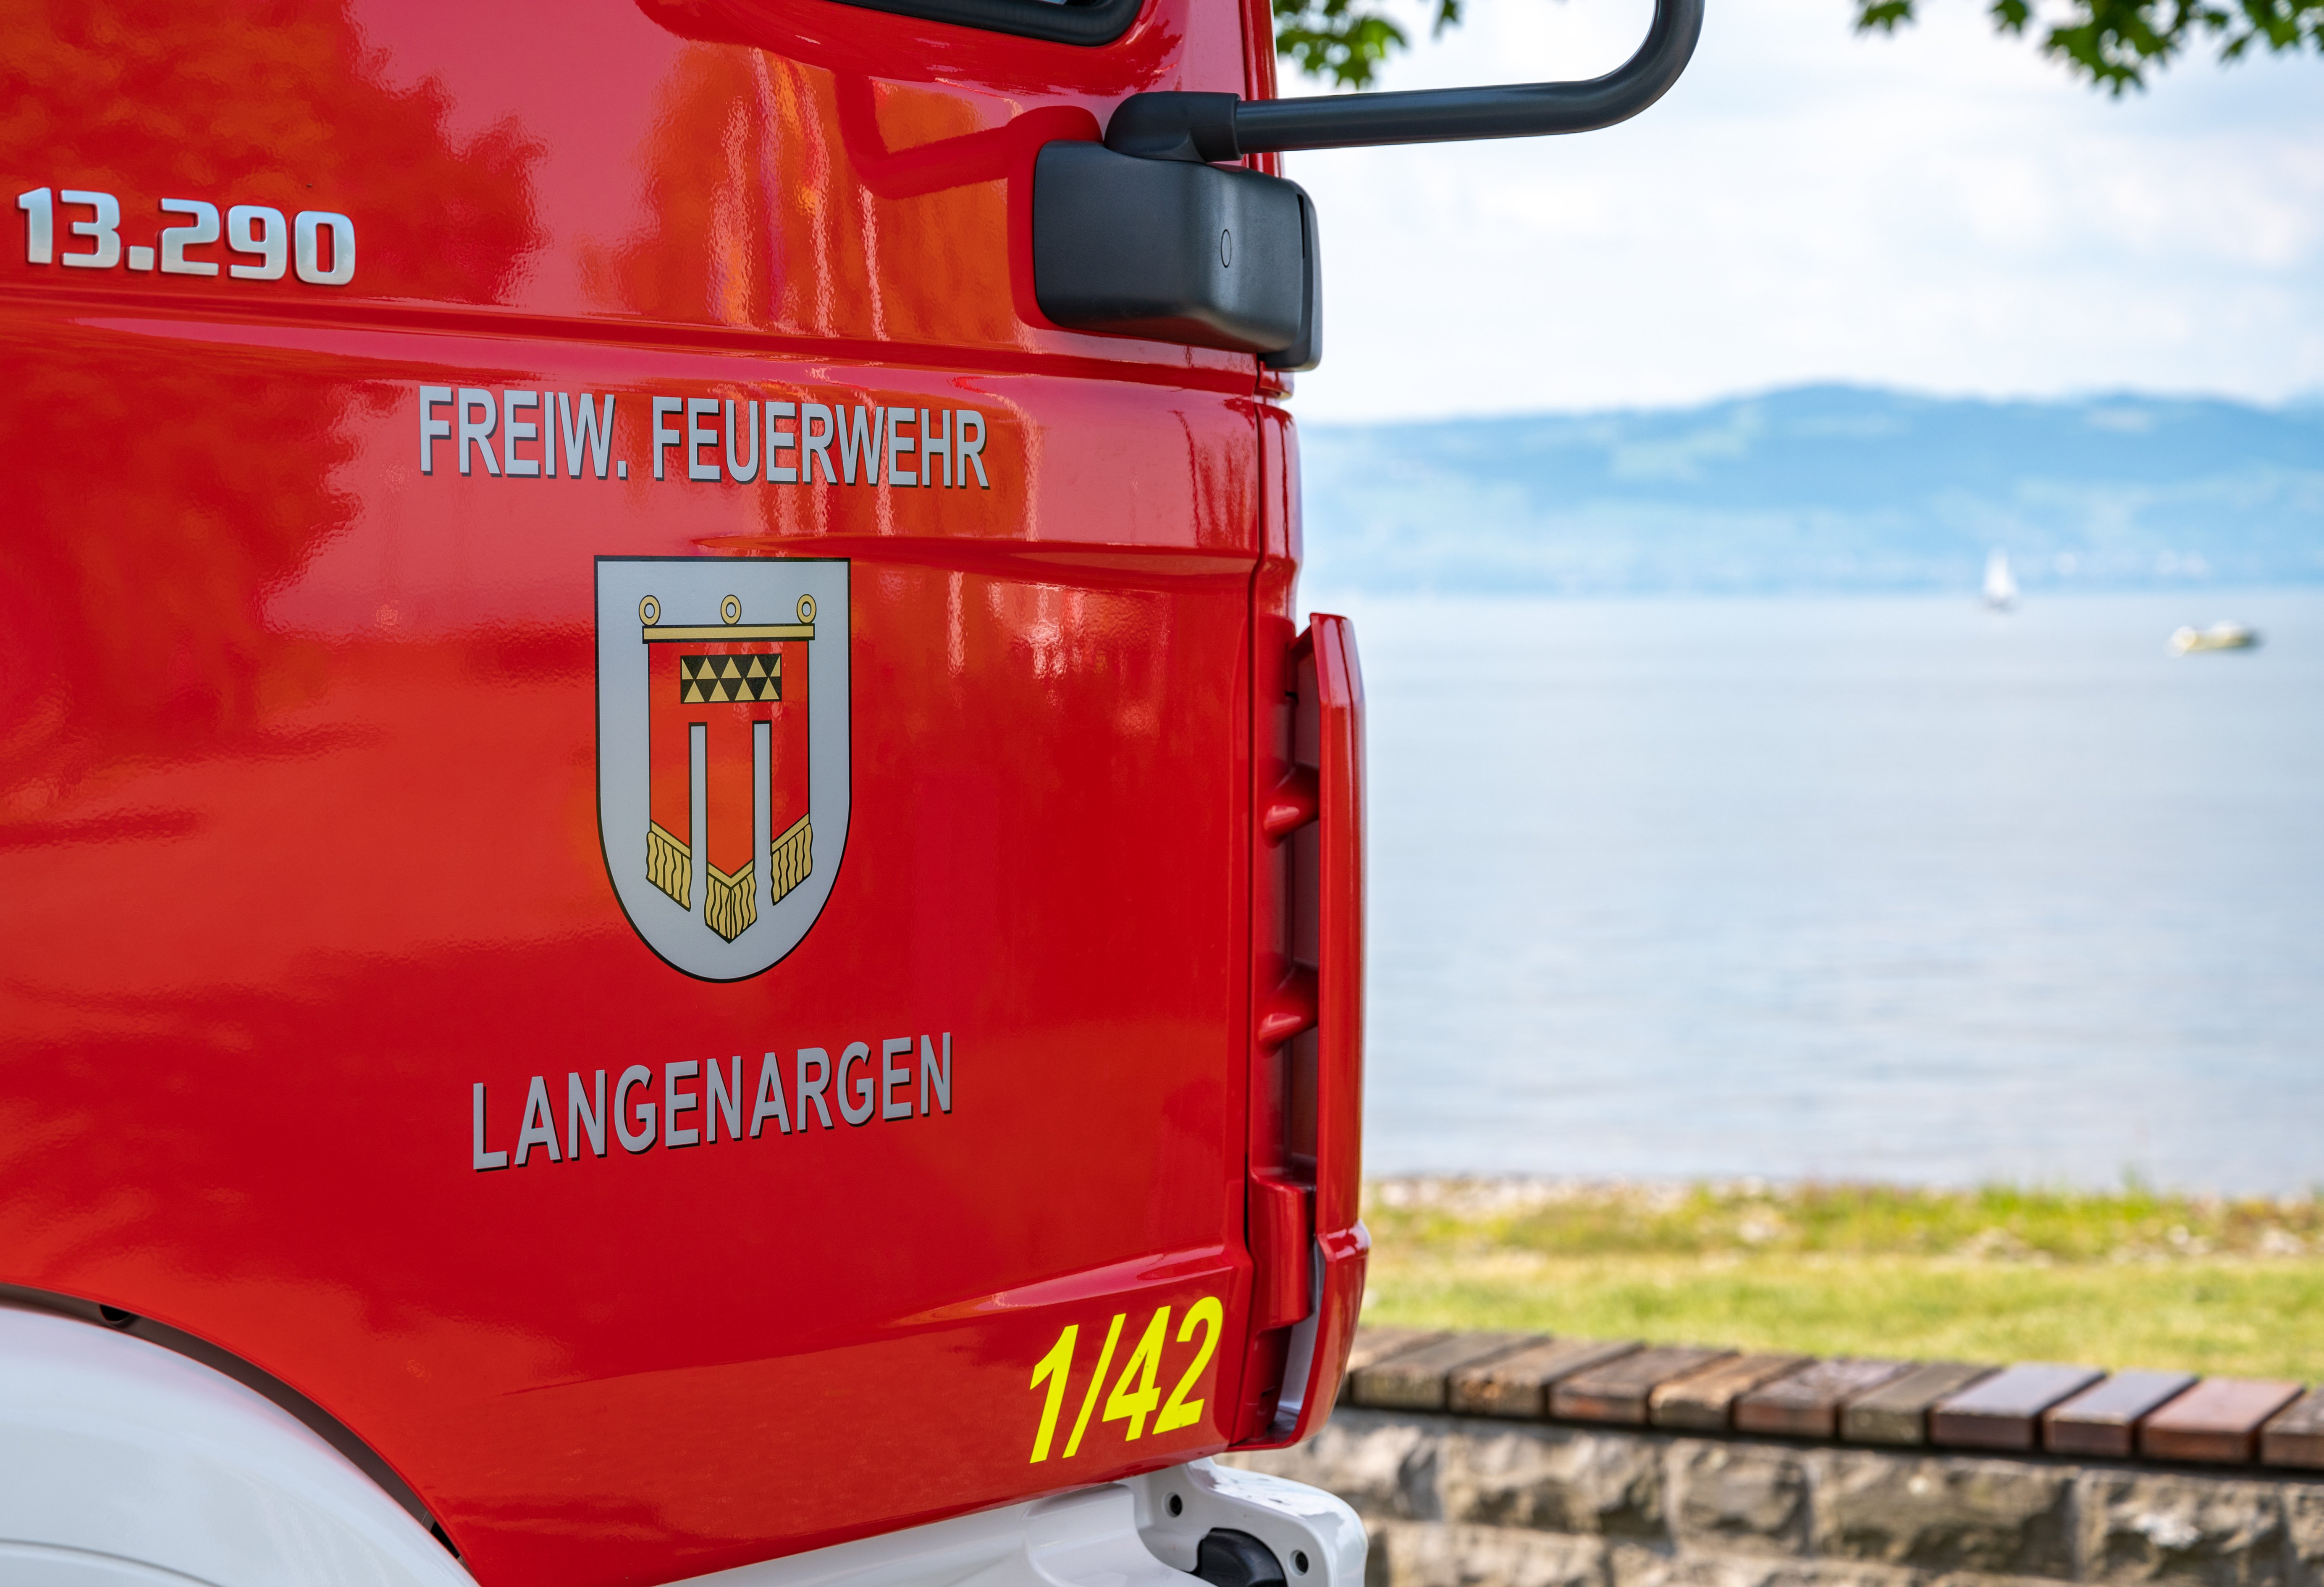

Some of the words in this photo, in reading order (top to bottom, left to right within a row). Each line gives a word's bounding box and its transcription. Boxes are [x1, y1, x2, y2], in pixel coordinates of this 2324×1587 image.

[16, 187, 355, 285] 13.290
[420, 385, 628, 479] FREIW.
[652, 396, 990, 490] FEUERWEHR
[473, 1032, 952, 1172] LANGENARGEN
[1029, 1296, 1224, 1464] 1/42
